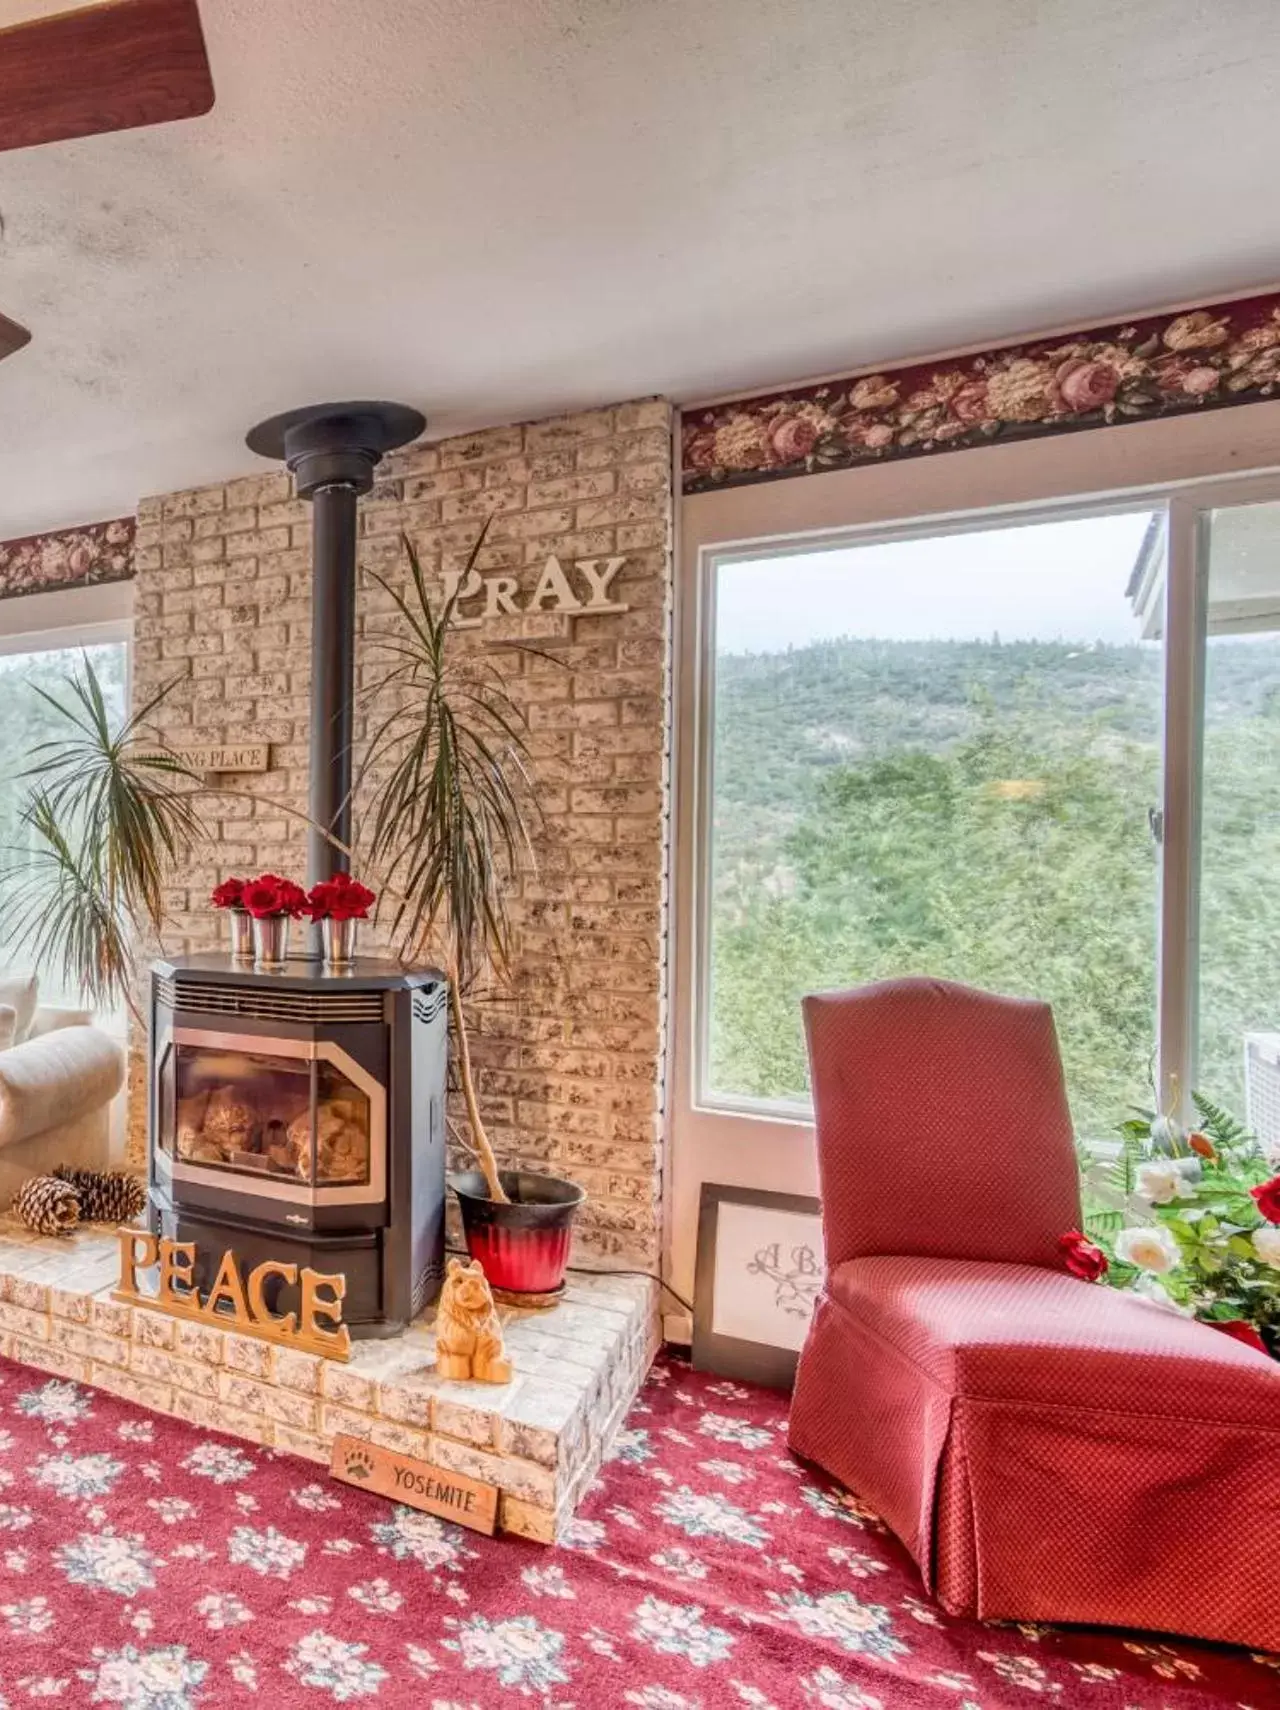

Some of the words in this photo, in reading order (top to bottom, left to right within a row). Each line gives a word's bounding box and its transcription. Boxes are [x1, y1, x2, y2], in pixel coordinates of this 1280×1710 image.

[438, 554, 627, 621] PRAY
[209, 748, 261, 768] PLACE
[114, 1226, 350, 1352] PEACE
[392, 1466, 477, 1514] YOSEMITE
